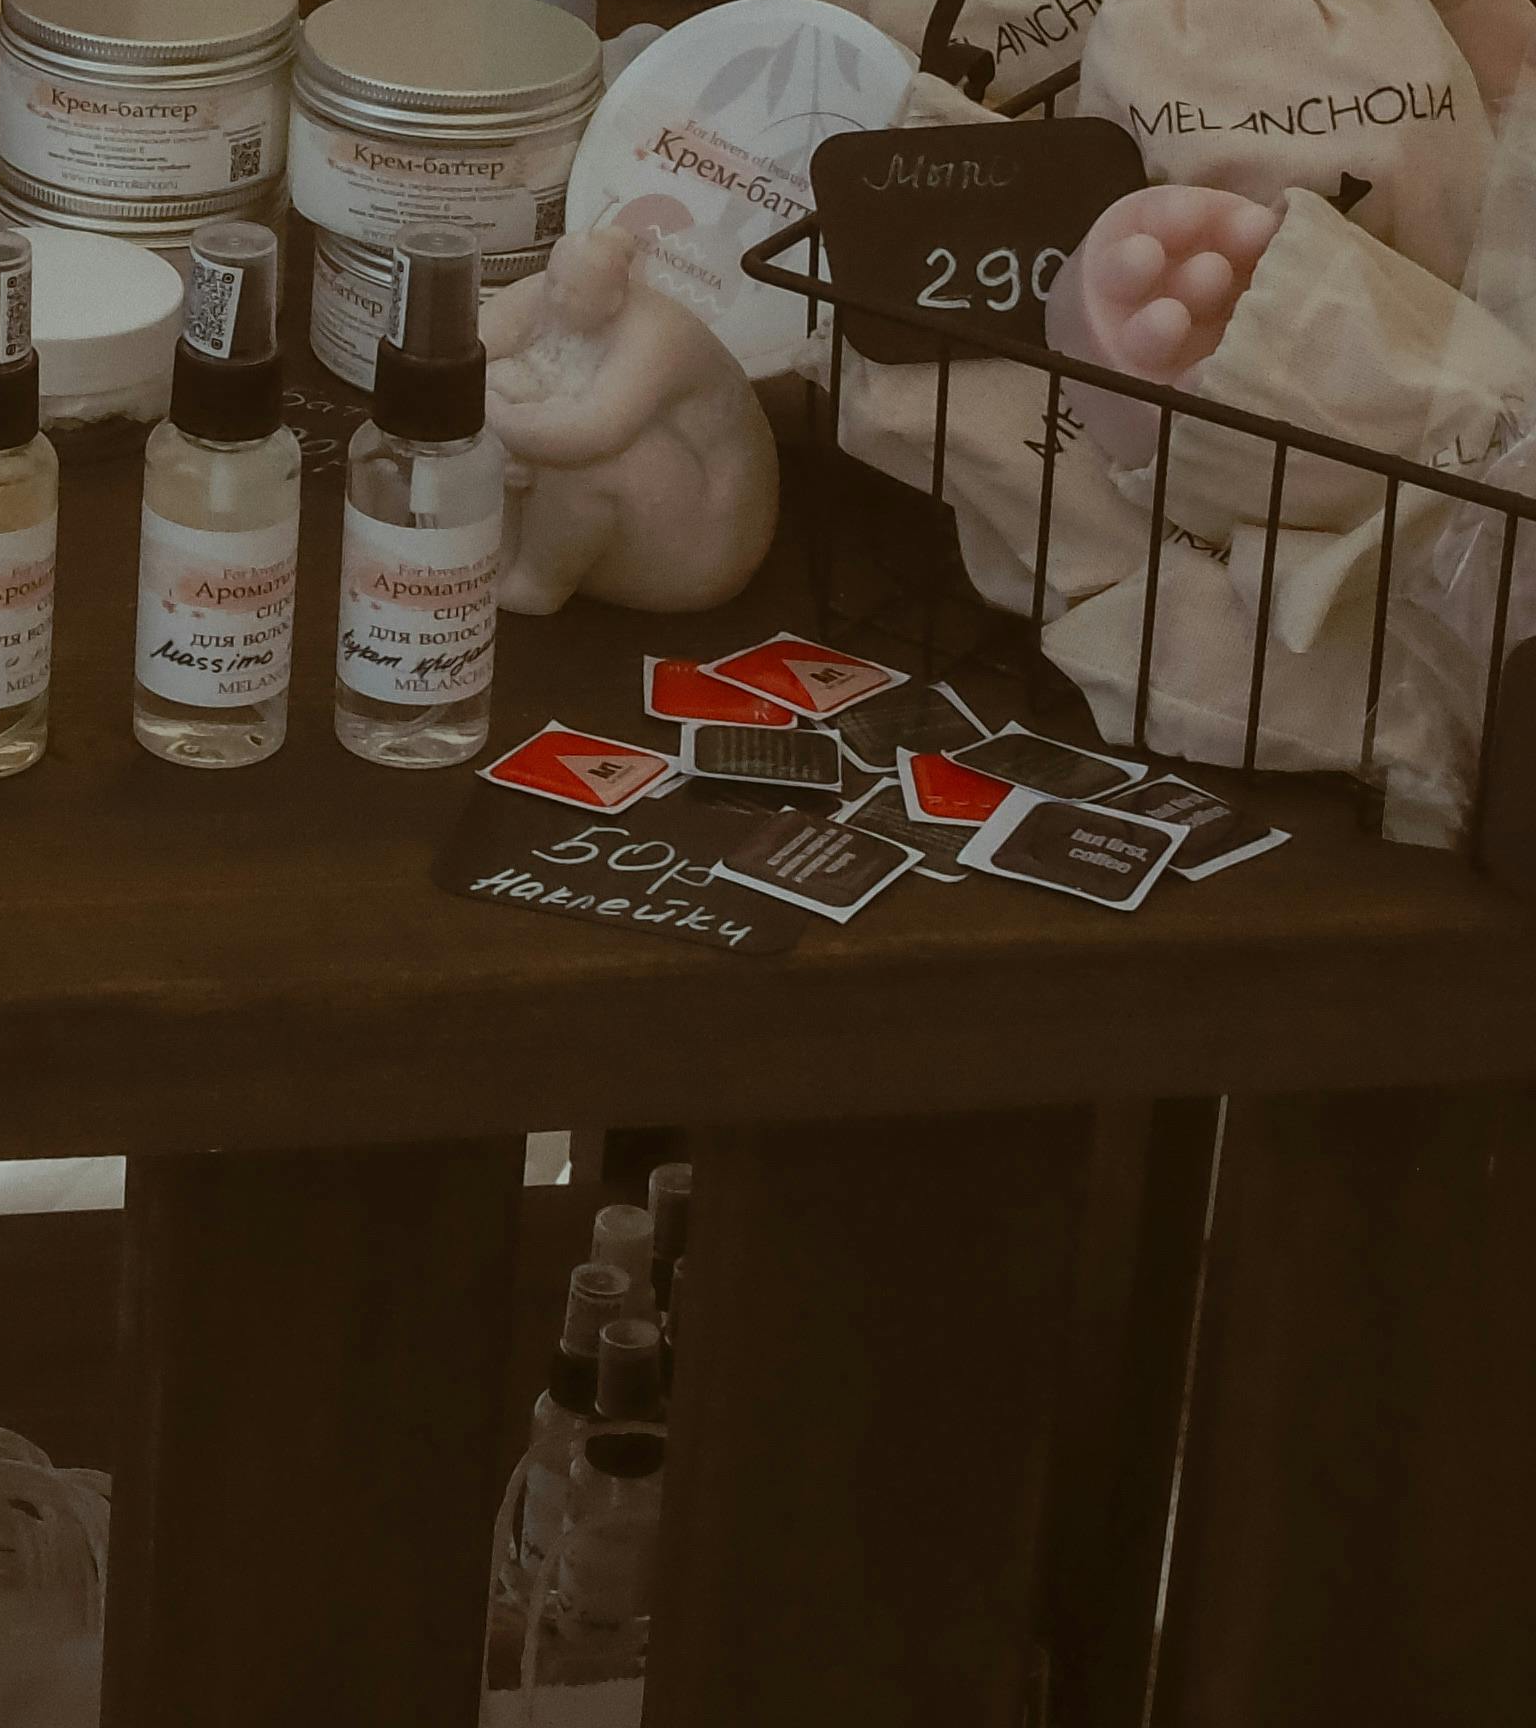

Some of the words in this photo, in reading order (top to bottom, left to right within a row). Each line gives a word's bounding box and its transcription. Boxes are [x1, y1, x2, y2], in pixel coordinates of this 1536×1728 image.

[51, 87, 198, 123] Крем-баттер
[1129, 84, 1456, 137] MELANCHOLIA
[354, 143, 504, 180] Крем-баттер
[651, 127, 815, 221] Крем-батт
[433, 593, 491, 622] спрей
[190, 631, 235, 650] для
[369, 623, 411, 645] для
[419, 624, 480, 646] волос
[149, 639, 274, 674] Massimo
[470, 868, 752, 947] Наклейки
